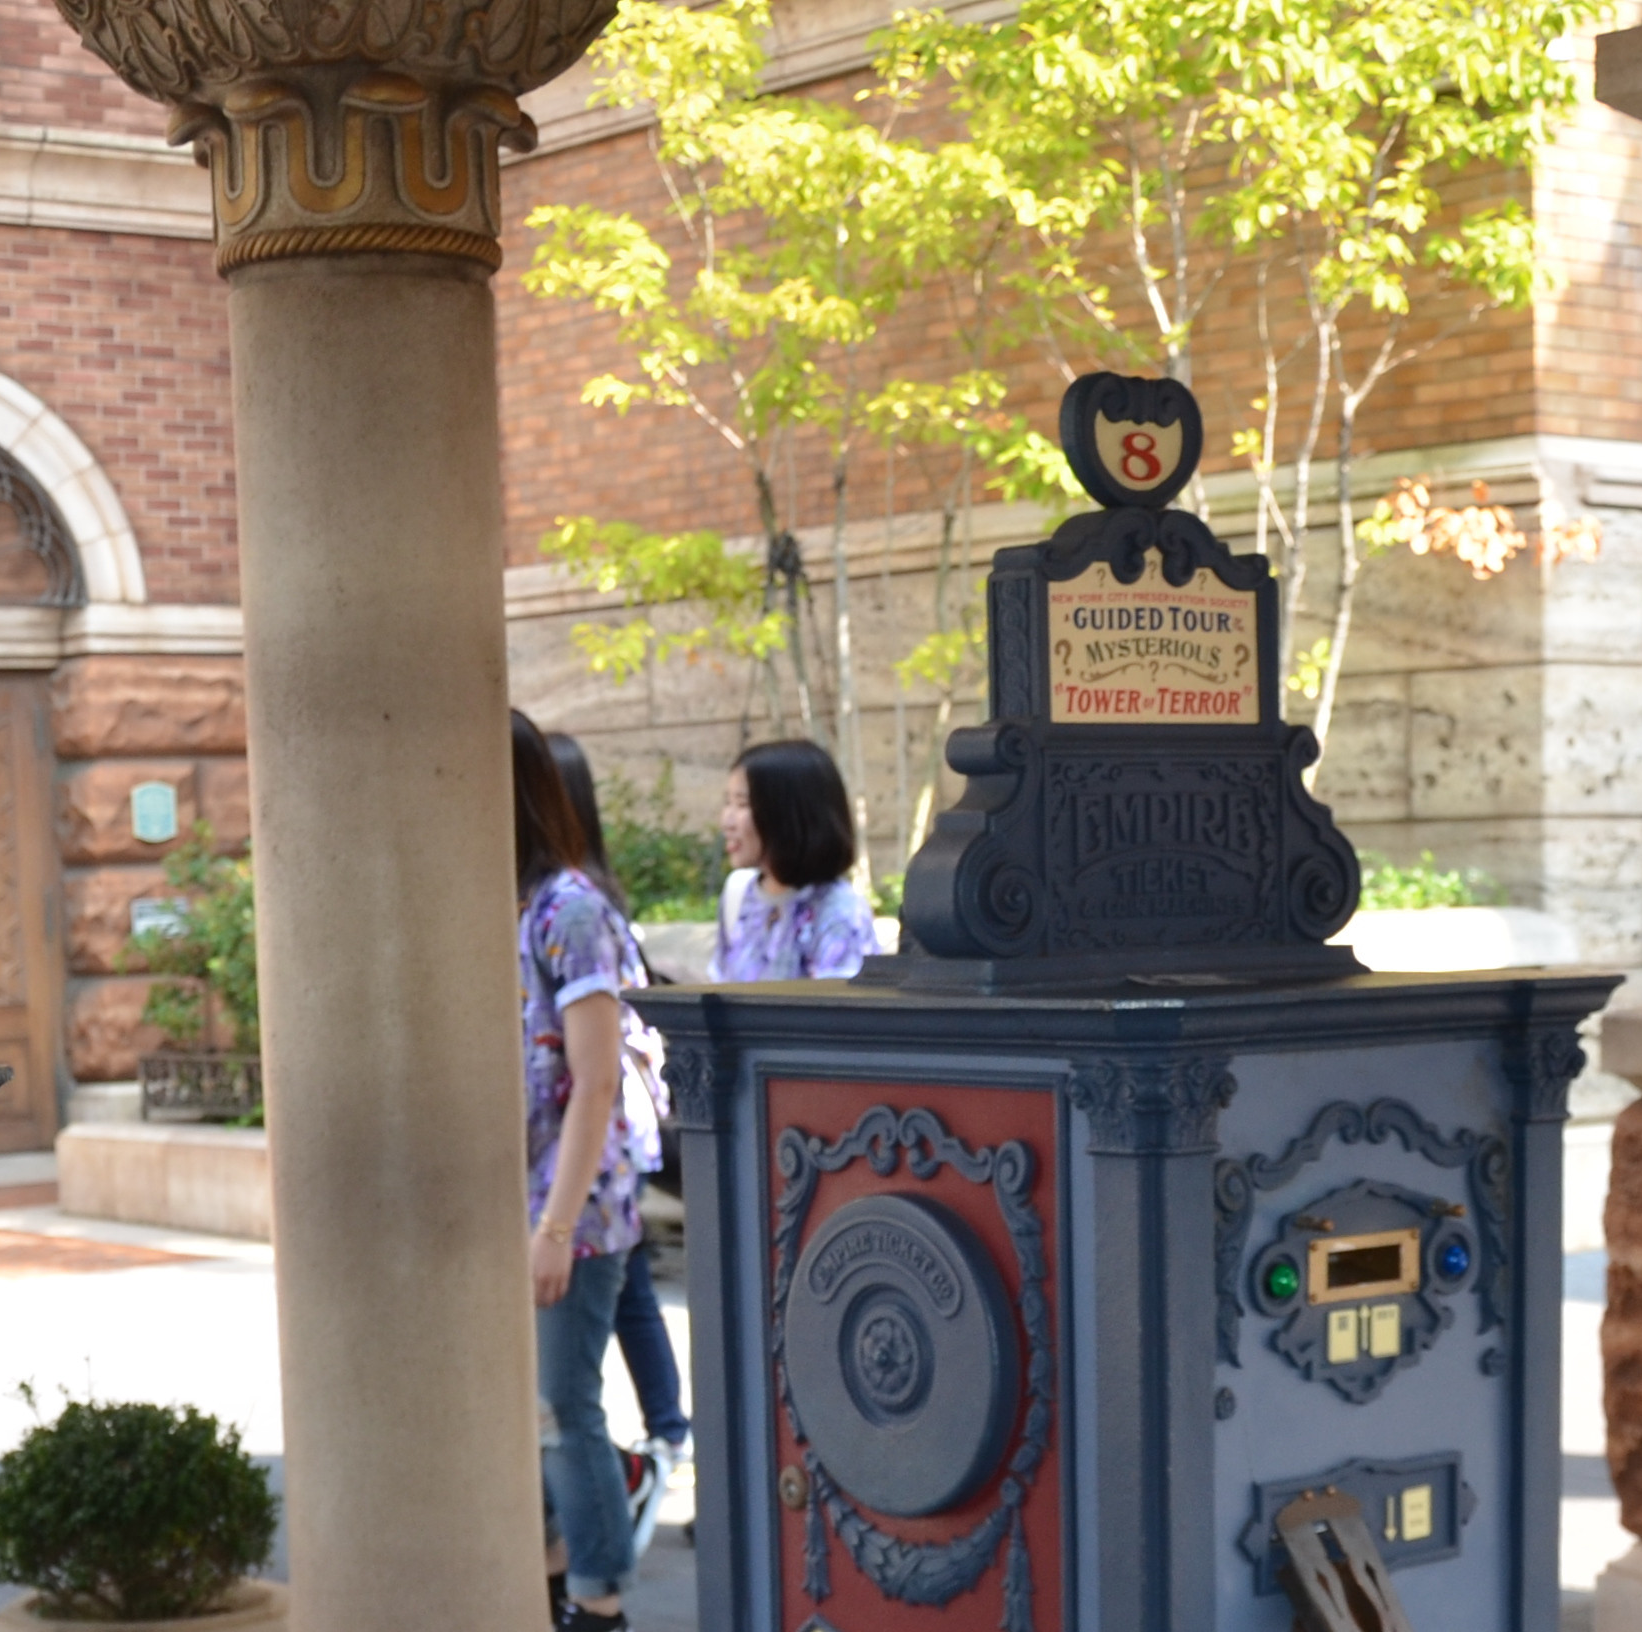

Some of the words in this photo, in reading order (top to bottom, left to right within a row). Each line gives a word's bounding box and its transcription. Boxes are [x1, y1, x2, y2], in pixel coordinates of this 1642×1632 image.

[1122, 430, 1162, 482] 8
[1073, 606, 1163, 631] GUIDED
[1168, 606, 1232, 633] TOUR
[1085, 637, 1222, 669] MYSTERIOUS
